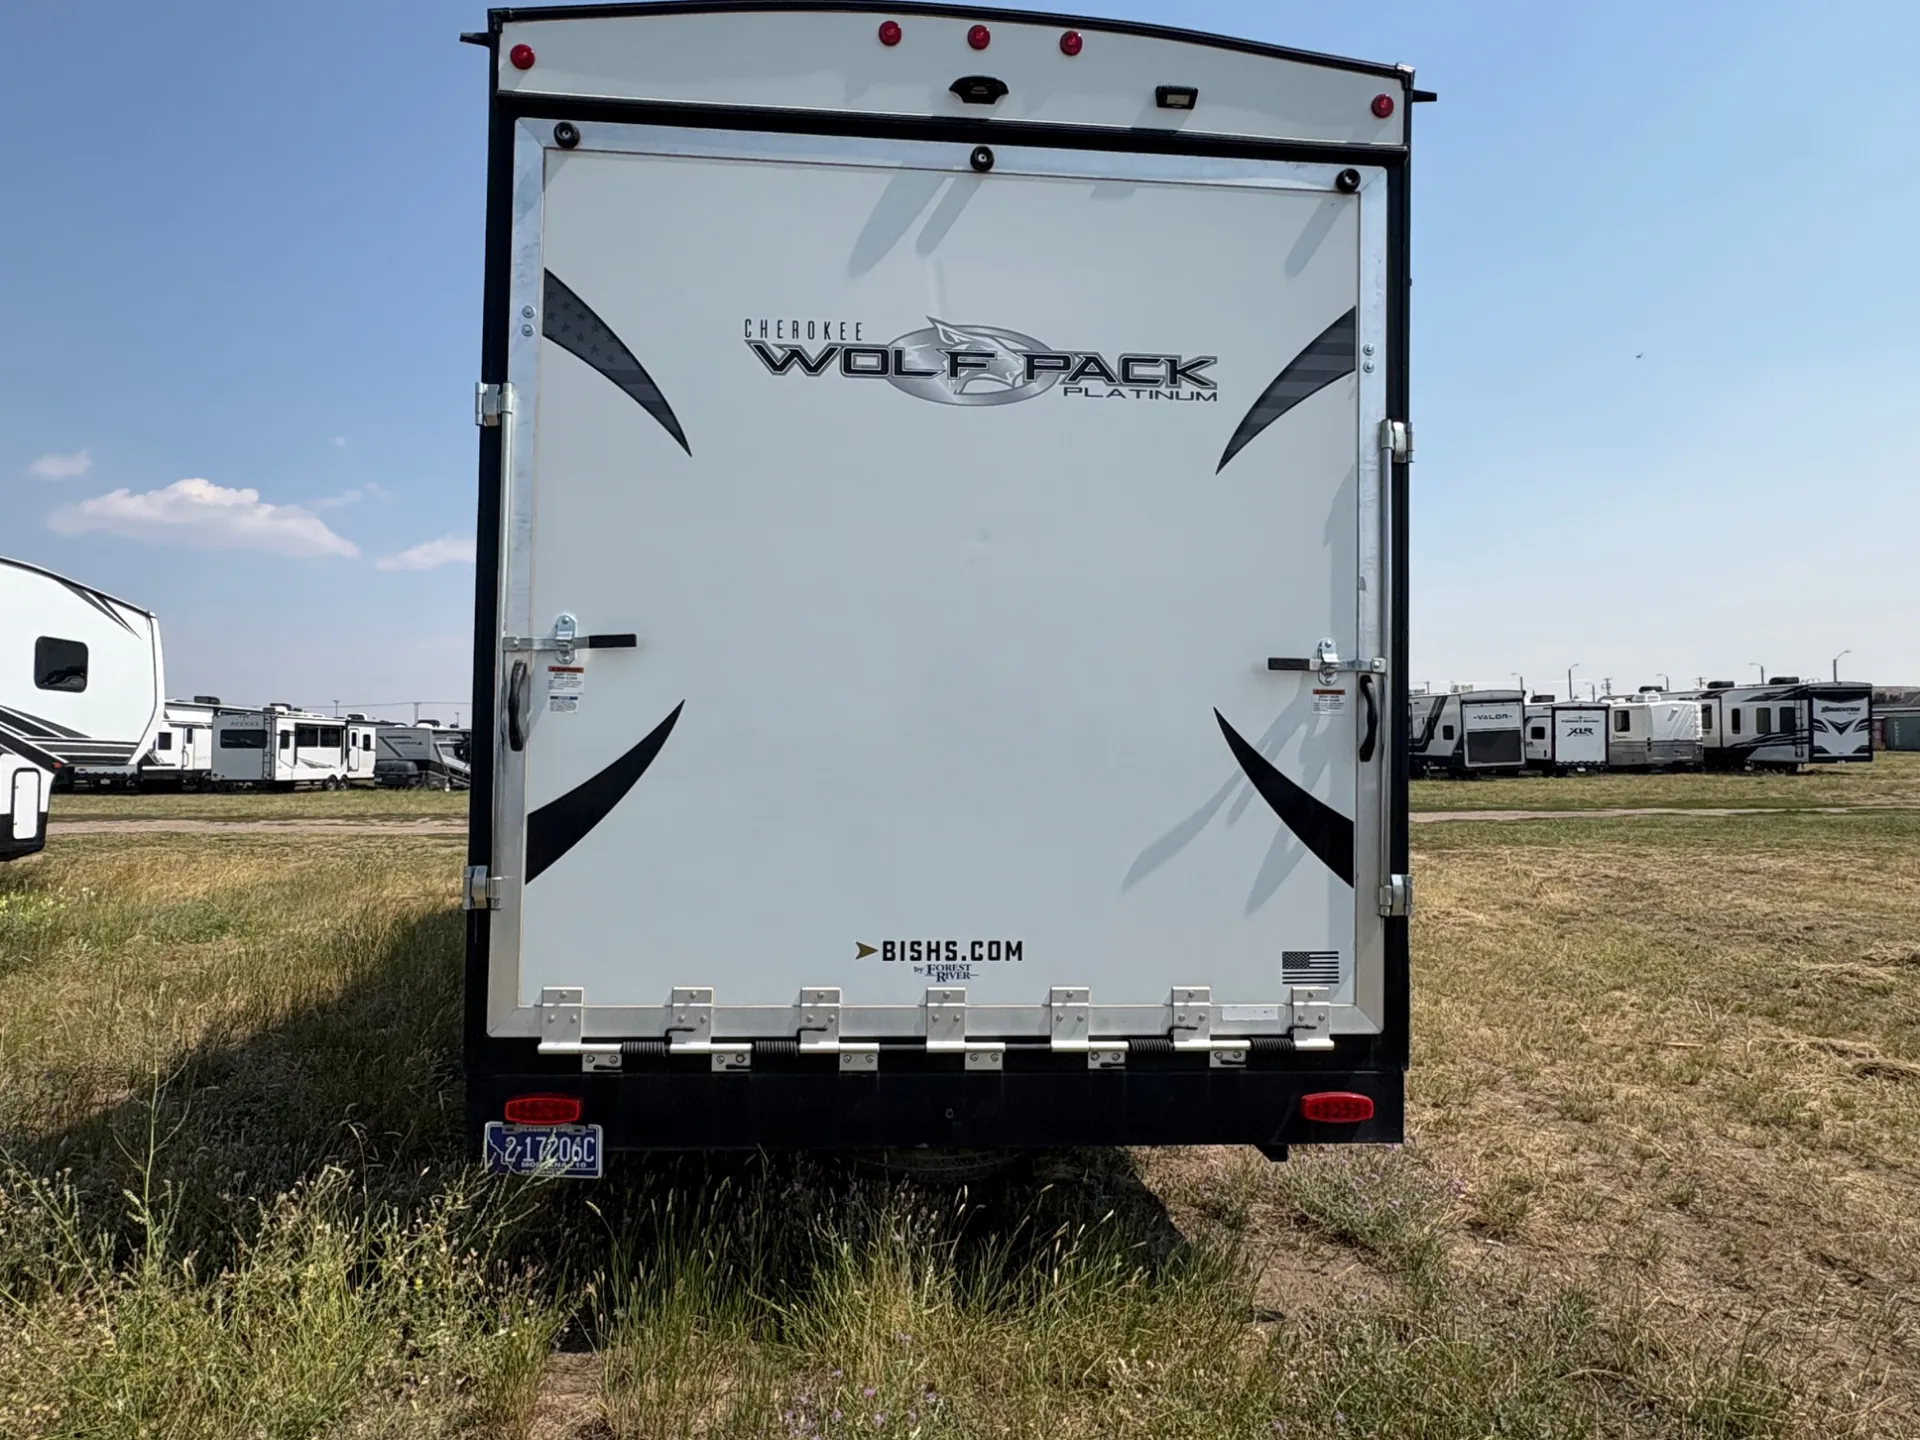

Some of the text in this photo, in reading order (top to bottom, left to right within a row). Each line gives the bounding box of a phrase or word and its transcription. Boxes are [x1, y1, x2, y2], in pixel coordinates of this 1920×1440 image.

[744, 318, 863, 342] CHEROKEE
[744, 340, 1218, 390] WOLF PACK
[1063, 386, 1218, 402] PLATINUM
[1477, 713, 1509, 721] VALOR
[1566, 727, 1595, 738] XLR
[882, 940, 1023, 962] BISHS.COM
[913, 963, 973, 977] by FOREST
[936, 971, 972, 983] RIVER
